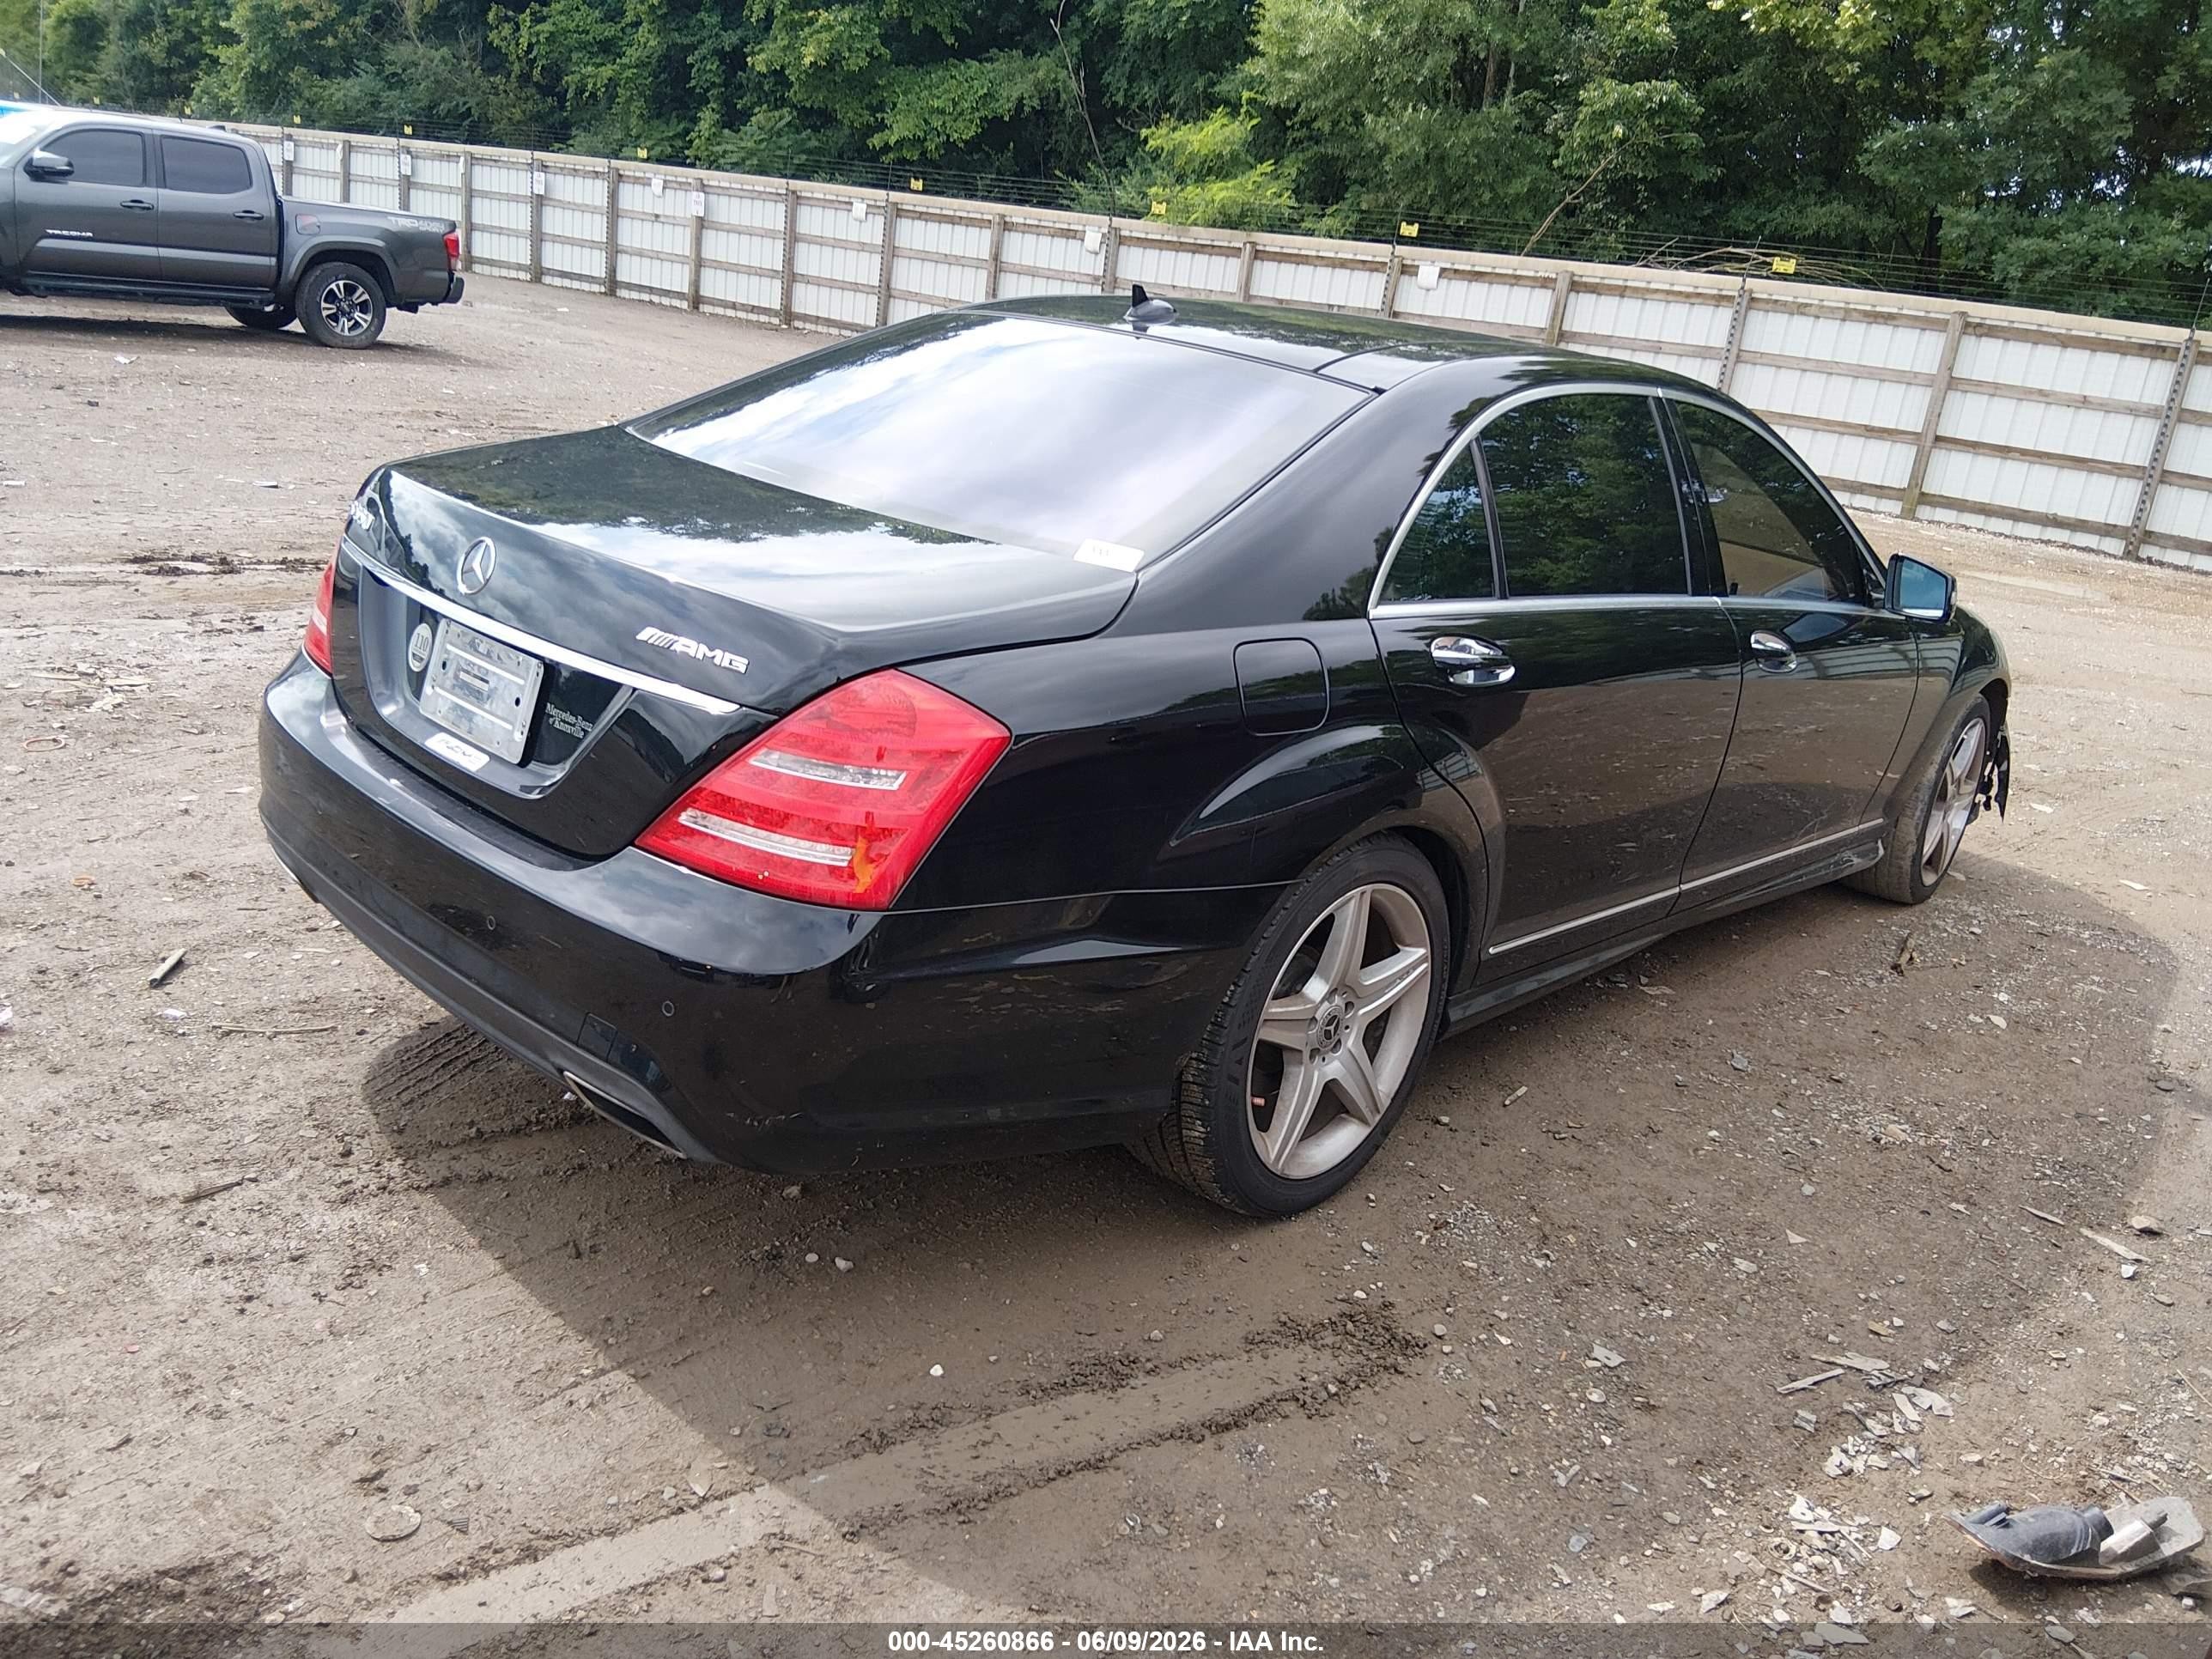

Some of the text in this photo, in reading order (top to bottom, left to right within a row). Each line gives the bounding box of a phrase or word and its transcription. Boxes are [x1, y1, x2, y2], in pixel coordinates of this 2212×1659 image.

[46, 228, 93, 237] TACOMA
[414, 632, 429, 653] 110
[544, 702, 593, 732] Mercedes-Benz
[552, 720, 585, 738] Knoxville
